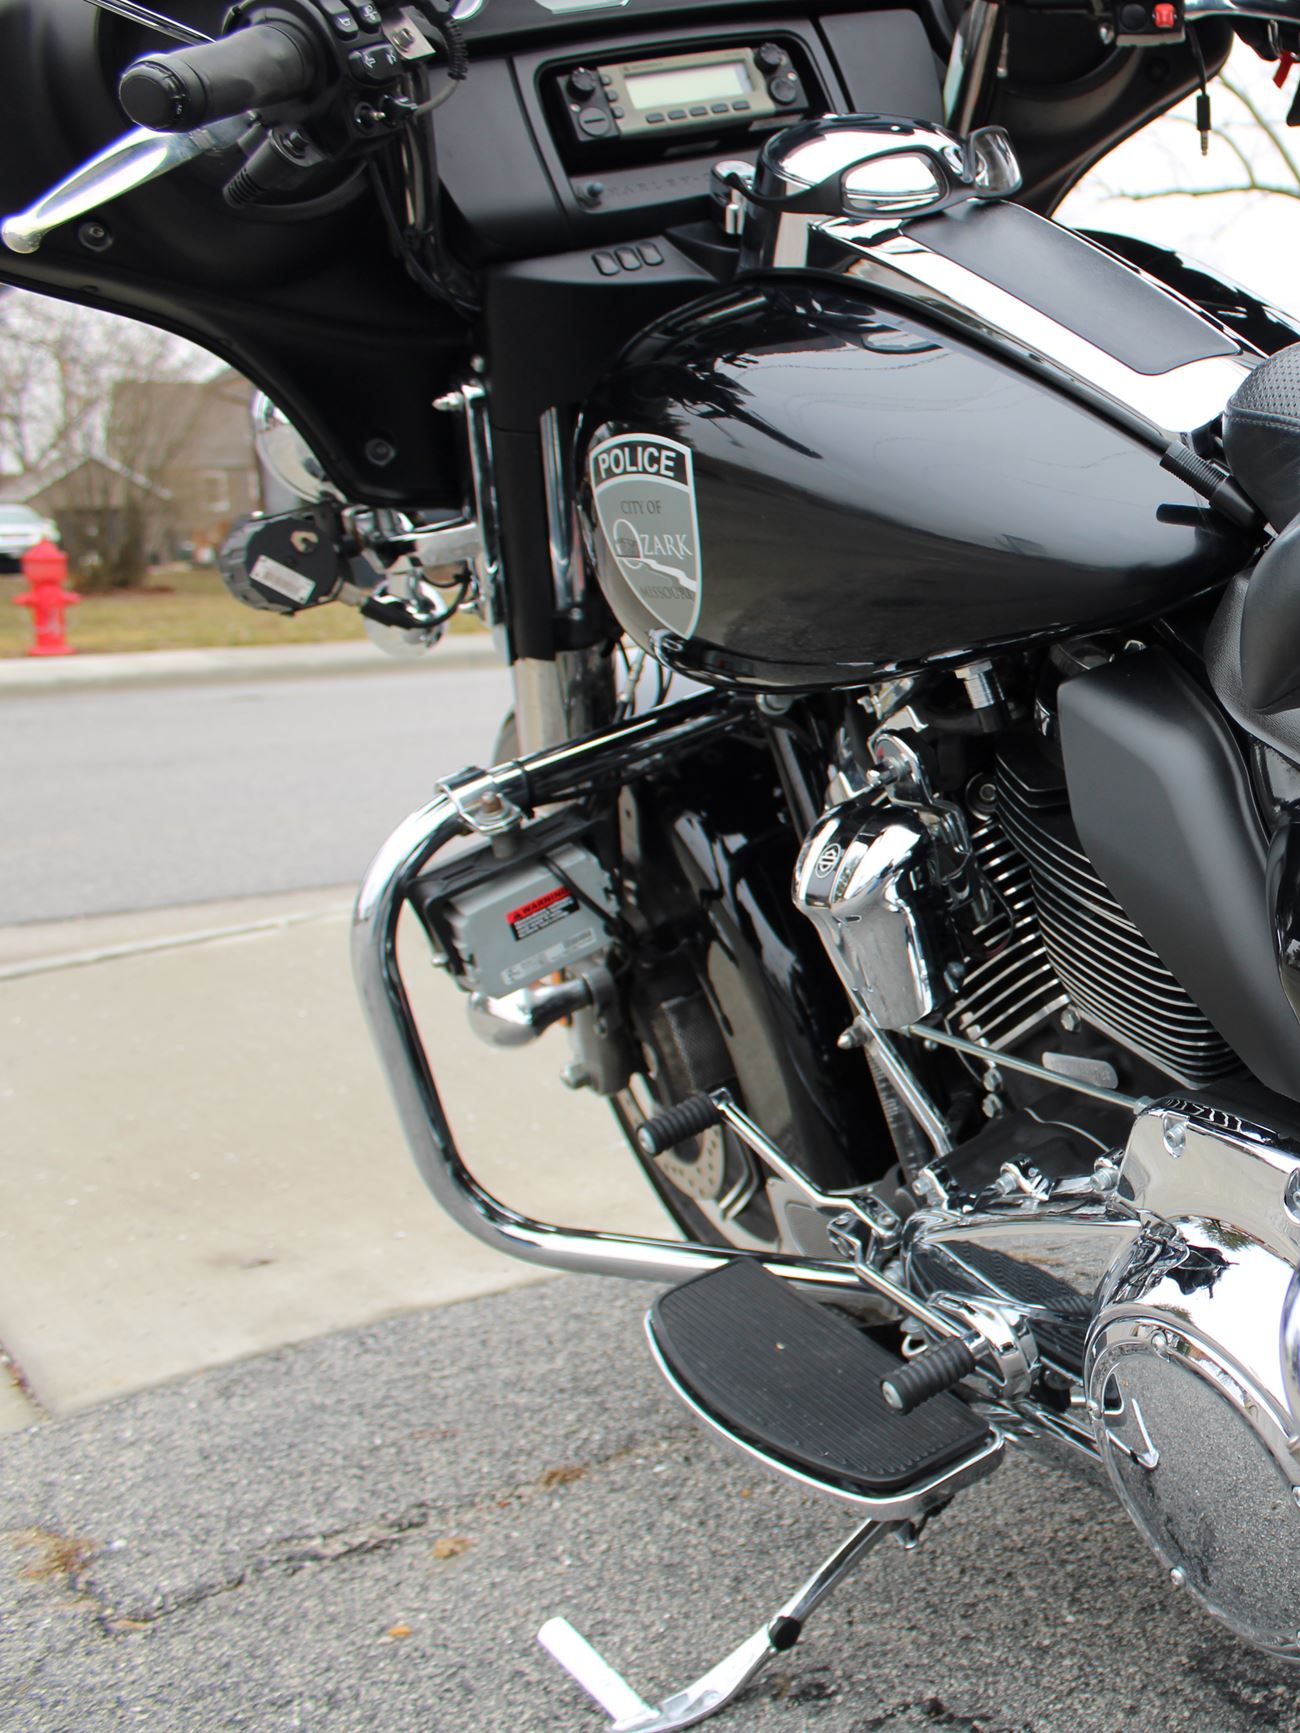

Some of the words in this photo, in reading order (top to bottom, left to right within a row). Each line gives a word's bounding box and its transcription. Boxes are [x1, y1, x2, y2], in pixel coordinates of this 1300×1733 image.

[597, 446, 677, 479] POLICE
[620, 500, 645, 515] CITY
[645, 500, 662, 515] OF
